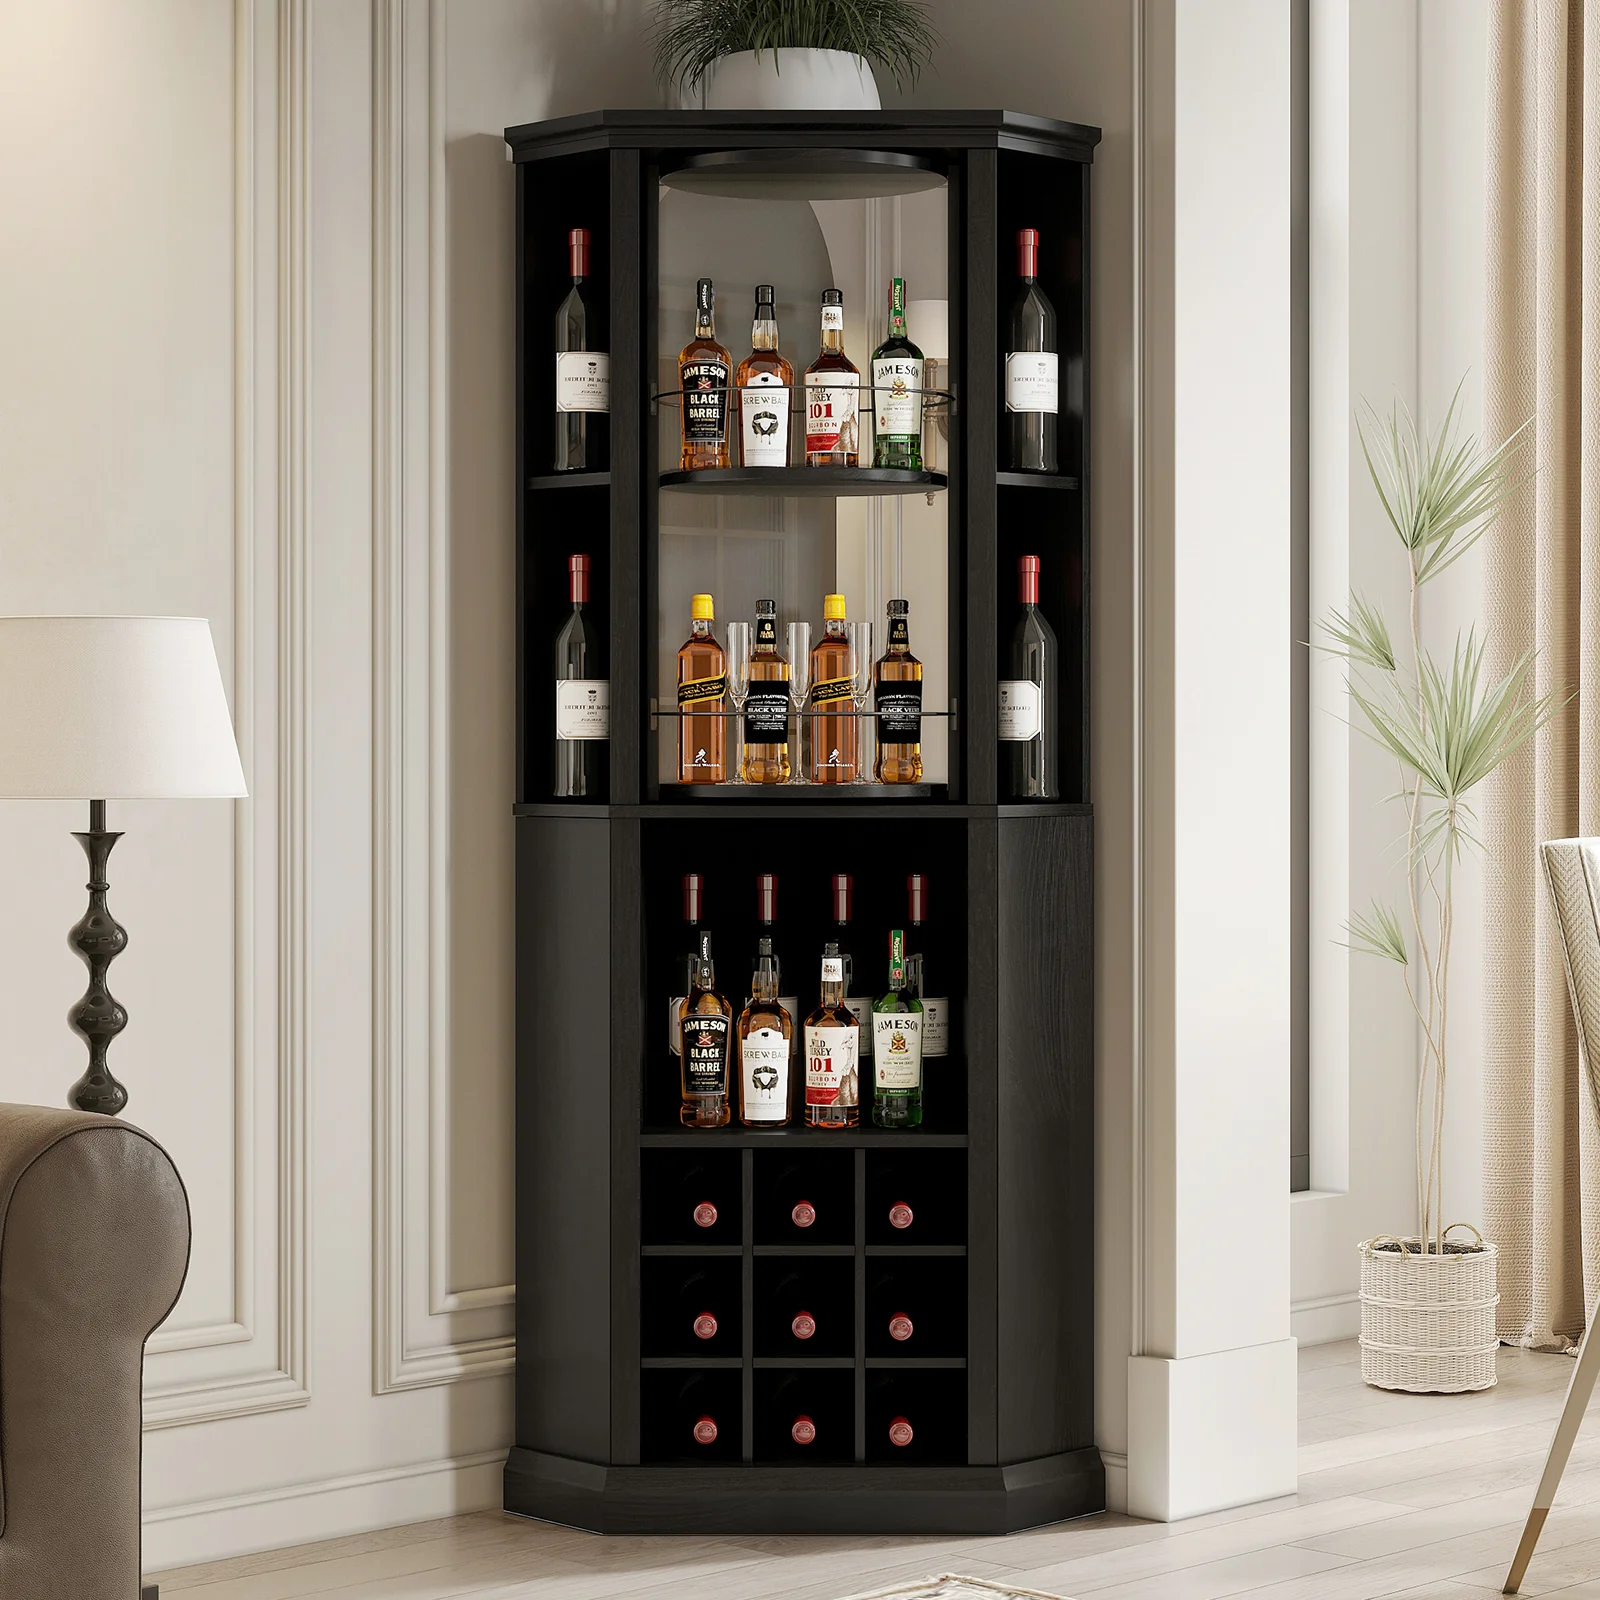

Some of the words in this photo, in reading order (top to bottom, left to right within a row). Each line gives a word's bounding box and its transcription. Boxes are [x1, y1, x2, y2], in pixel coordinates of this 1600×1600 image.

[684, 365, 726, 380] JAMESON
[878, 364, 920, 380] JAMESON
[690, 394, 719, 405] BLACK
[689, 408, 720, 419] BARREL
[809, 403, 834, 419] 101
[684, 1020, 727, 1033] JAMESON
[877, 1019, 919, 1033] JAMESON
[690, 1048, 720, 1058] BLACK
[690, 1062, 721, 1072] BARREL
[809, 1057, 834, 1073] 101
